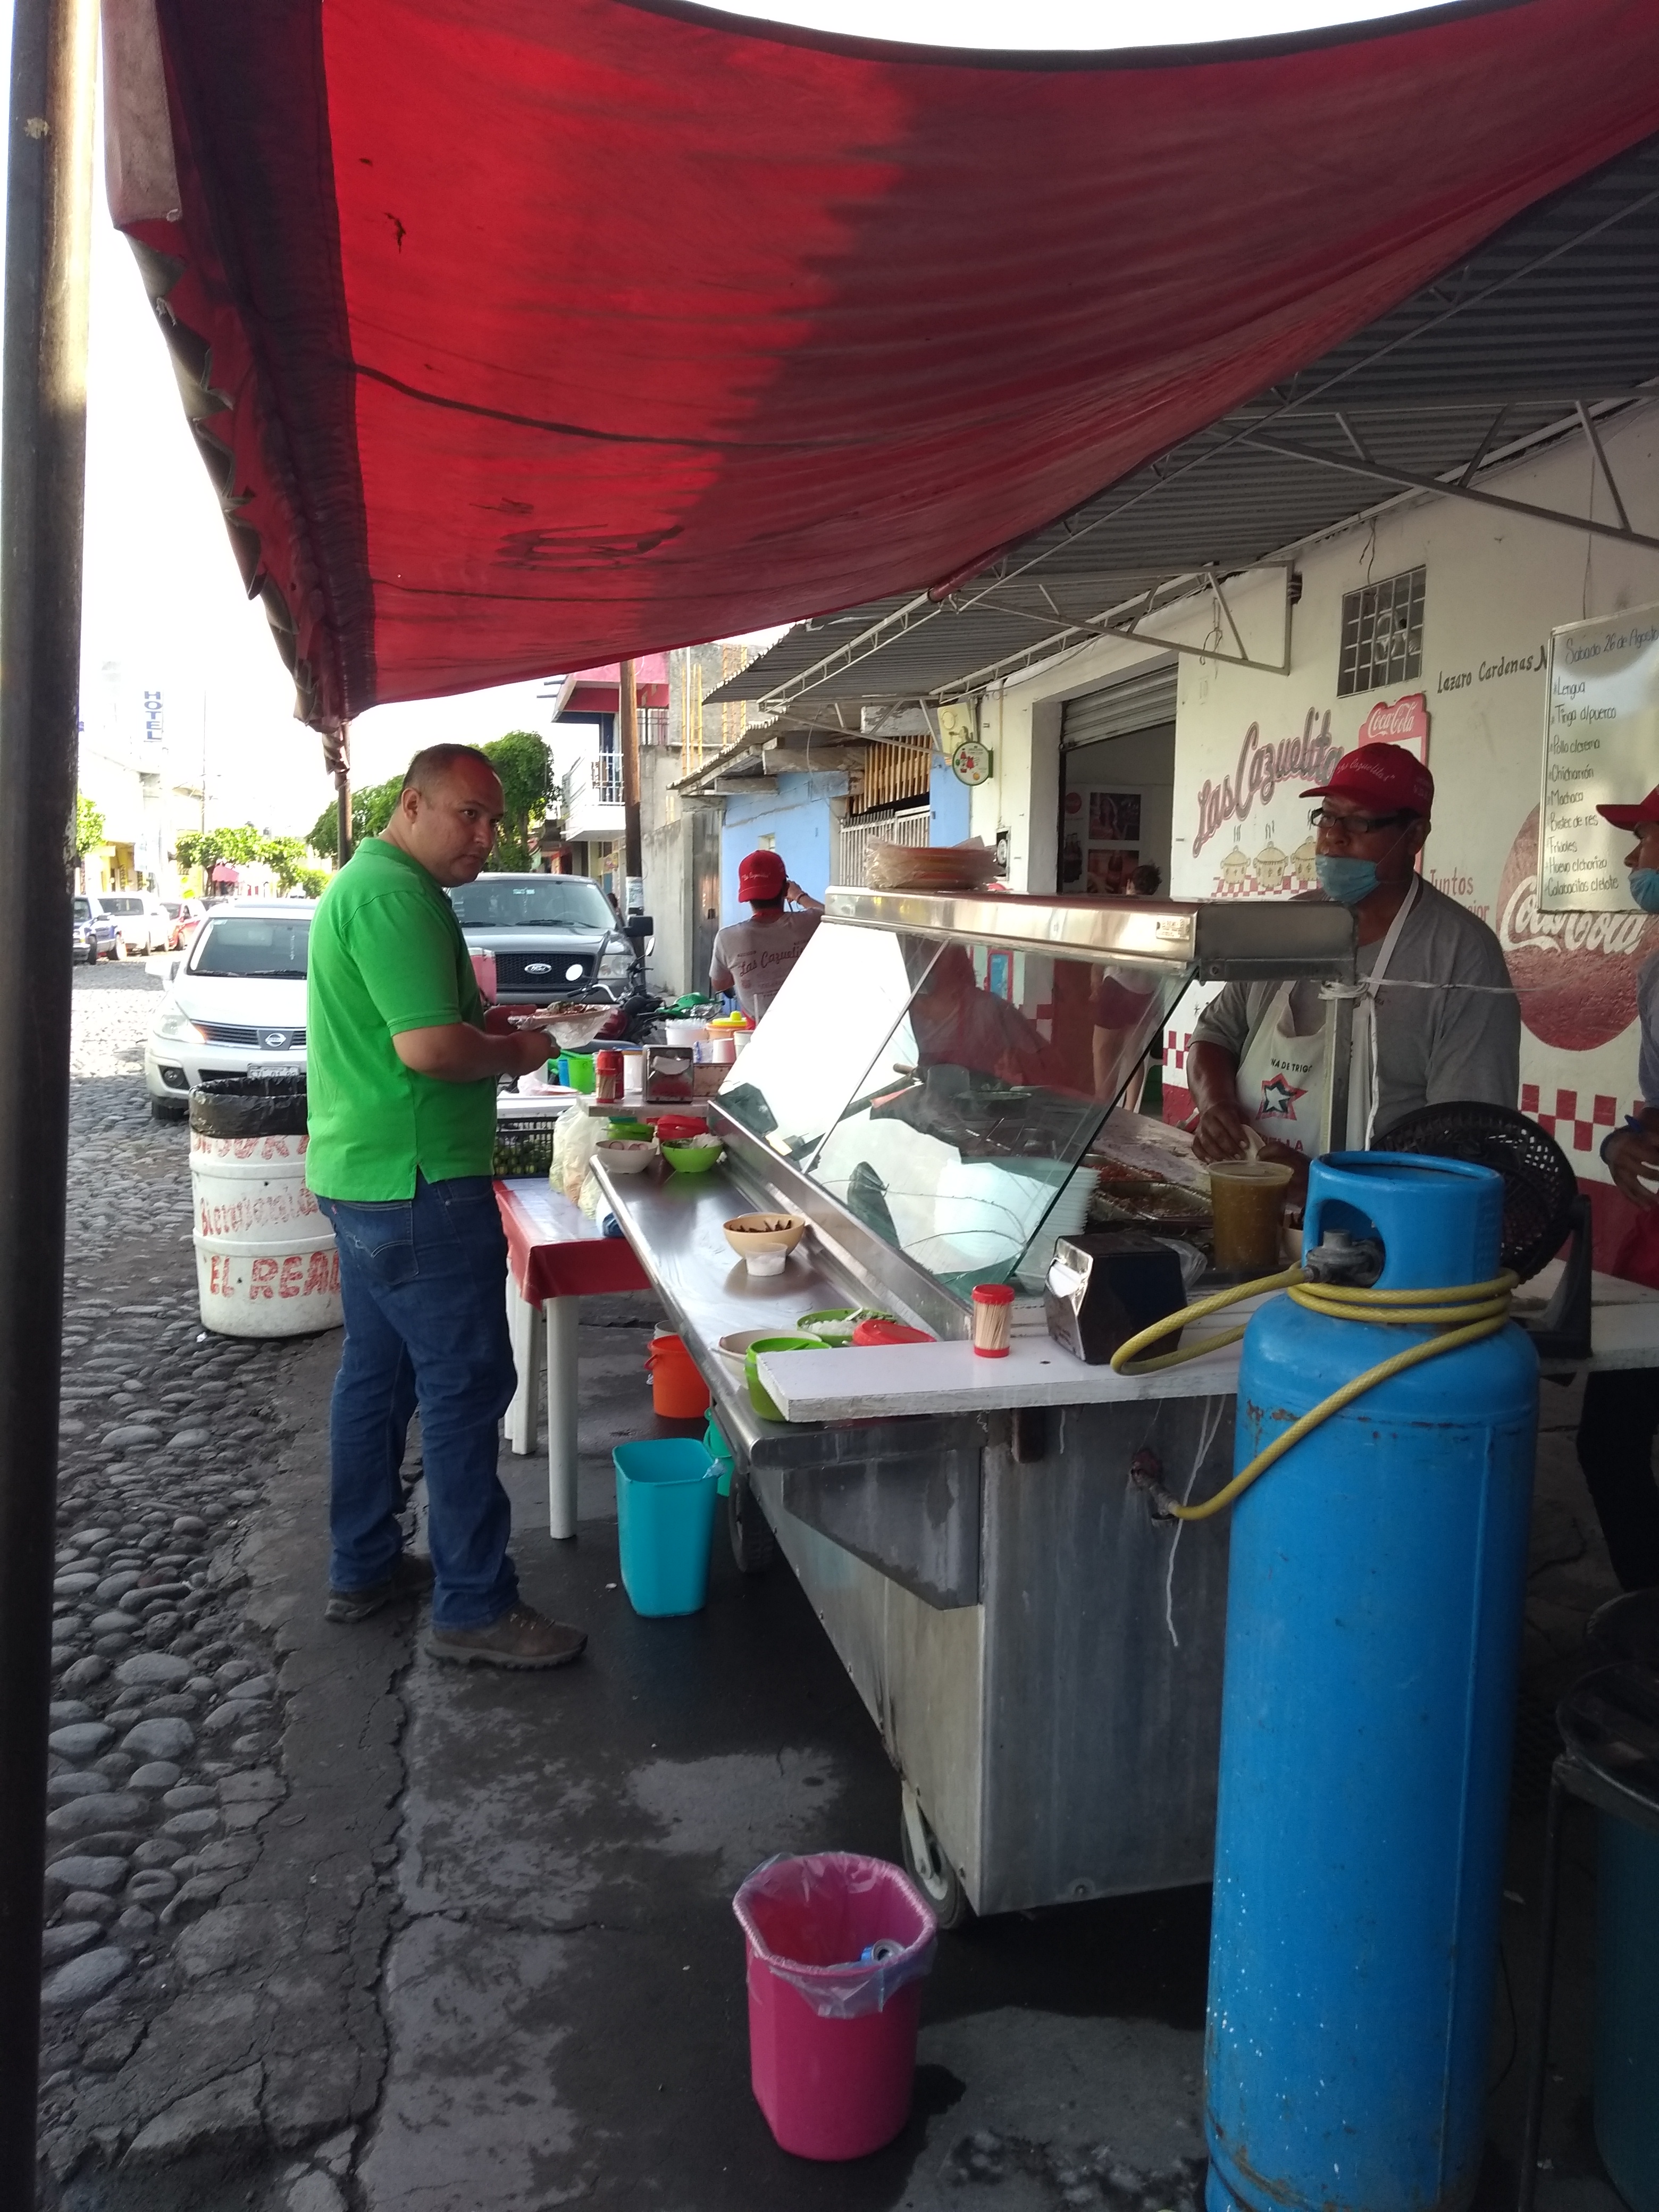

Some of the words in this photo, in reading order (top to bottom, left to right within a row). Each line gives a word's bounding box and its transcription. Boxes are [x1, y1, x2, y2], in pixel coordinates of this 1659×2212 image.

[1603, 633, 1615, 652] 26
[1616, 635, 1628, 649] de
[1629, 625, 1658, 648] Agosto
[1437, 671, 1472, 694] Lazaro
[1479, 655, 1534, 682] Cardenas
[1557, 676, 1585, 700] Lengua
[144, 691, 162, 740] HOTEL
[1368, 701, 1418, 738] Coca-Cola
[1555, 703, 1577, 727] Tinga
[1553, 734, 1569, 755] Pollo
[1193, 779, 1236, 859] Las
[1234, 706, 1344, 822] Cazuelita
[1551, 789, 1583, 806] Machaca
[1550, 811, 1572, 832] Bistec
[1573, 817, 1583, 828] de
[1585, 813, 1598, 826] res
[1549, 857, 1570, 874] Huevo
[1547, 877, 1589, 897] Calabacitas
[740, 961, 757, 977] Las
[1281, 1061, 1290, 1070] DE
